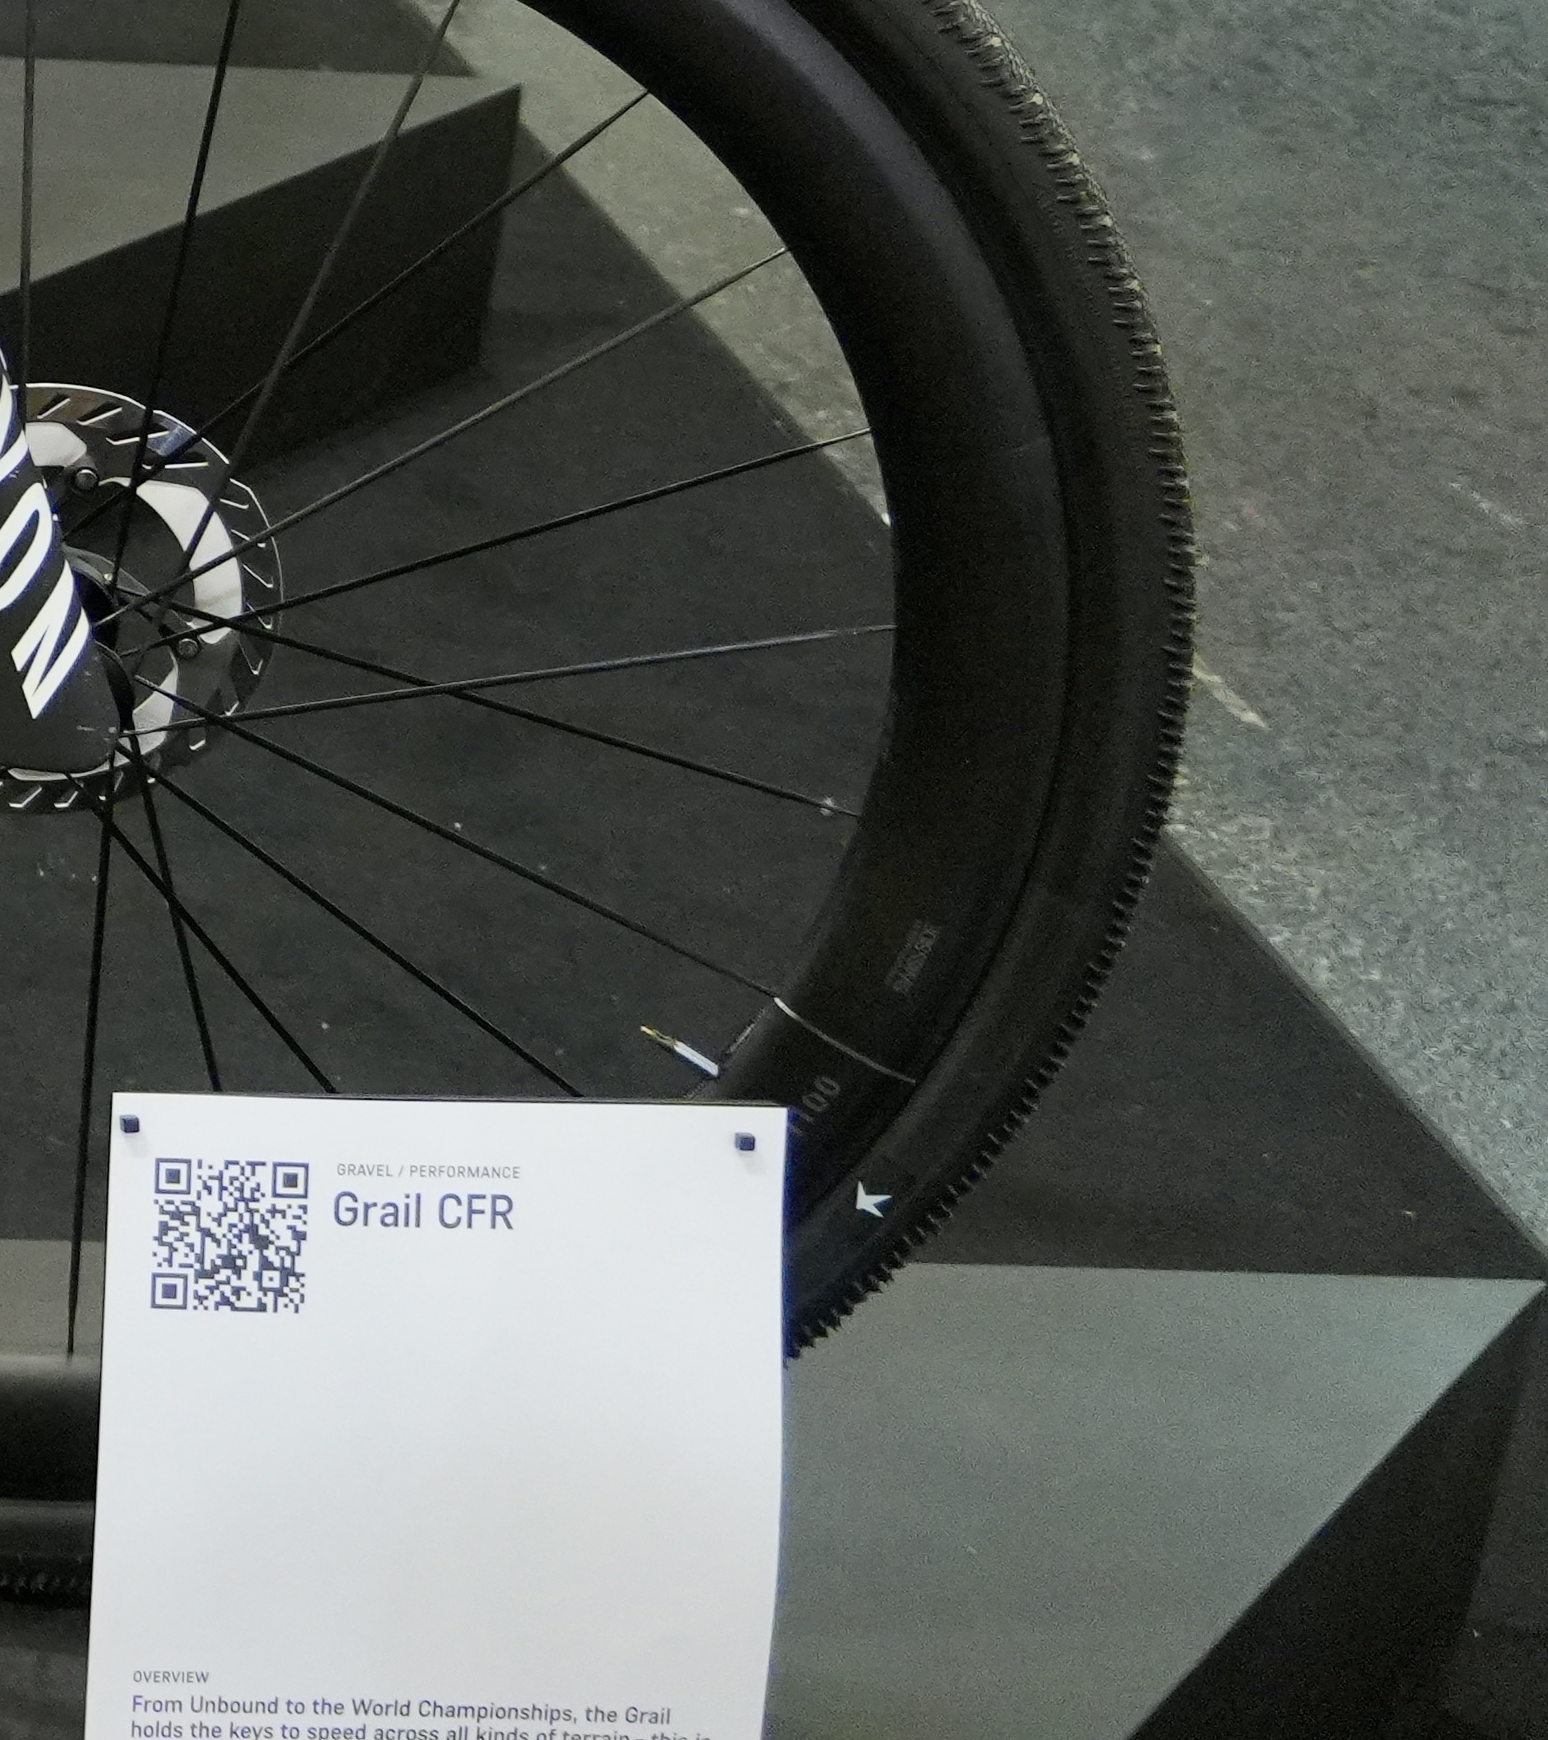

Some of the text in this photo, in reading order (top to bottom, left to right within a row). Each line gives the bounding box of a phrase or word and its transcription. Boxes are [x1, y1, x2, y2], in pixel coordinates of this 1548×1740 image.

[336, 1162, 521, 1180] GRAVEL / PERFORMANCE
[333, 1190, 514, 1231] Grail CFR
[132, 1669, 210, 1684] OVERVIEW
[132, 1694, 672, 1726] From Unbound to the World Championships, the Grail
[130, 1719, 184, 1739] holds
[189, 1720, 223, 1739] the
[229, 1720, 274, 1740] keys
[279, 1723, 301, 1740] to
[306, 1723, 367, 1740] speed
[373, 1727, 440, 1740] across
[445, 1725, 469, 1740] all
[475, 1725, 530, 1740] kinds
